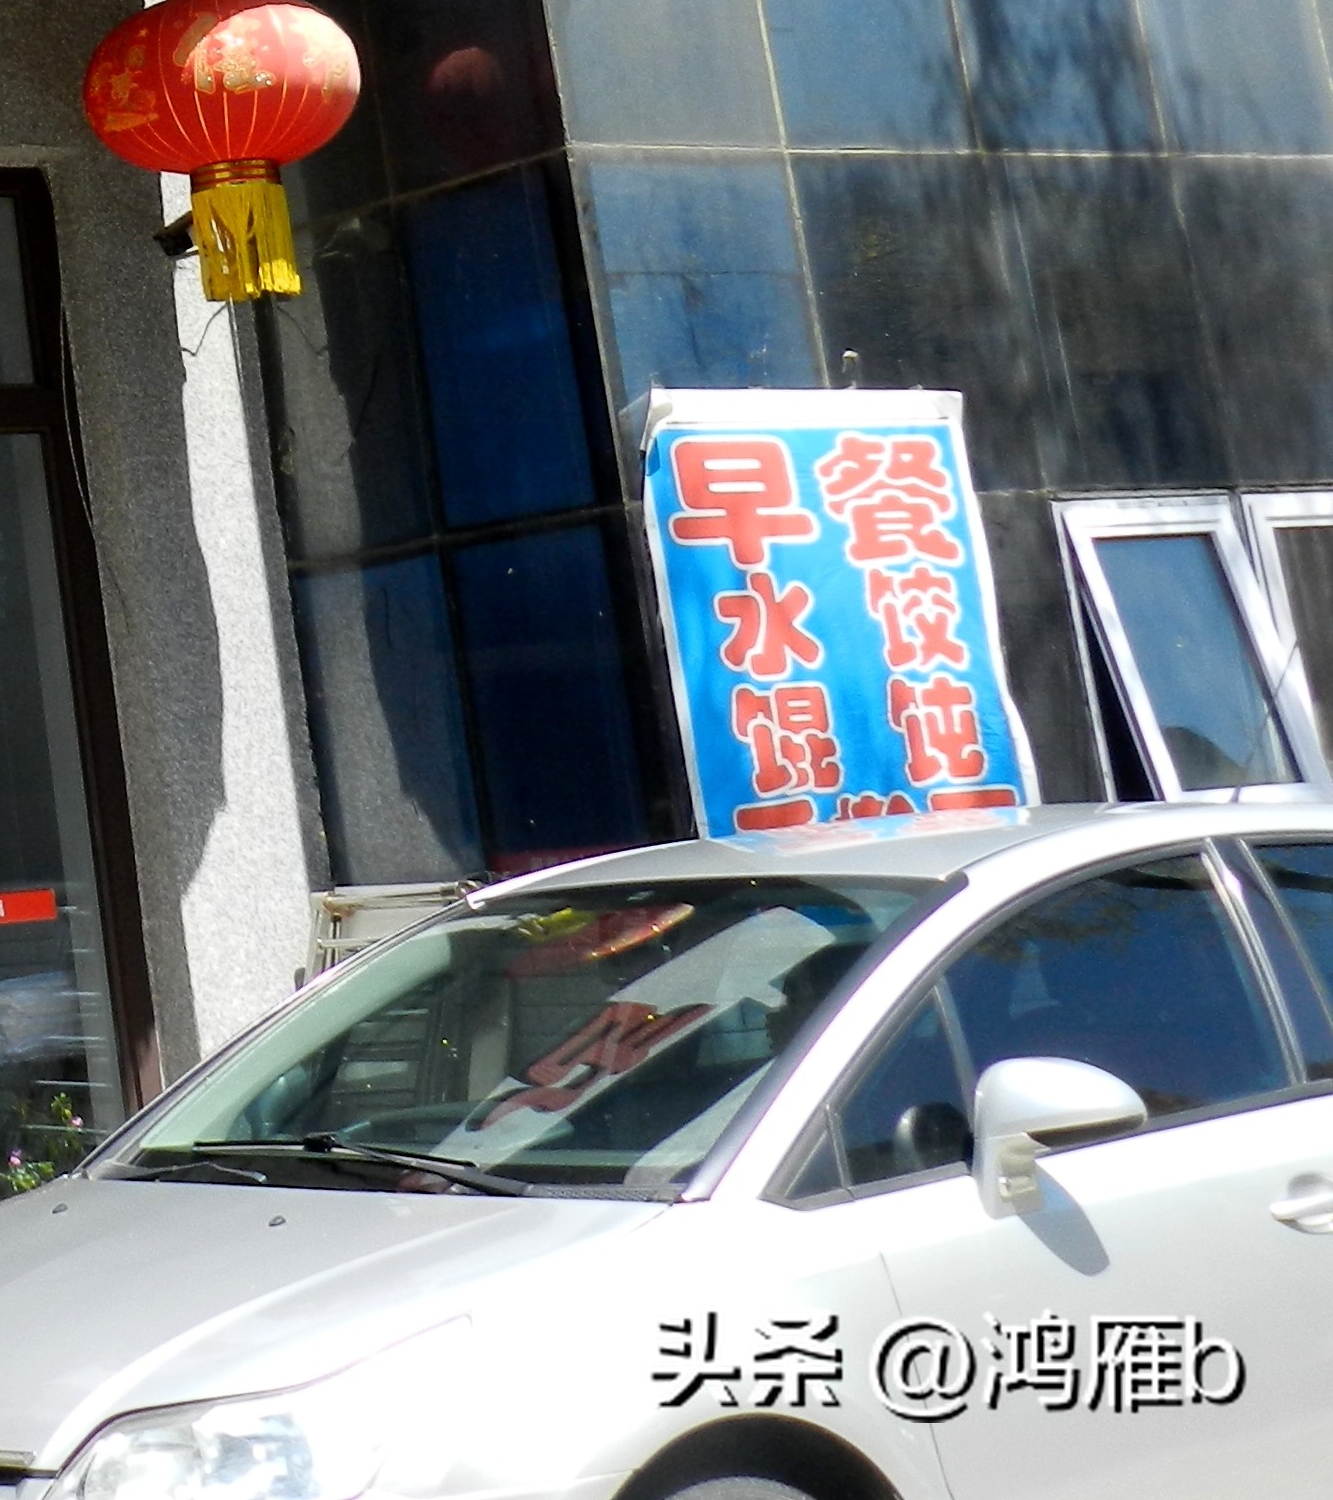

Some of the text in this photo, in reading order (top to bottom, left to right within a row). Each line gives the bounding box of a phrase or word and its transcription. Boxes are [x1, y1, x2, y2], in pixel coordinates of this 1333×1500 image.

[670, 436, 960, 566] 早餐
[717, 567, 965, 677] 水饺
[735, 677, 984, 794] 馄饨
